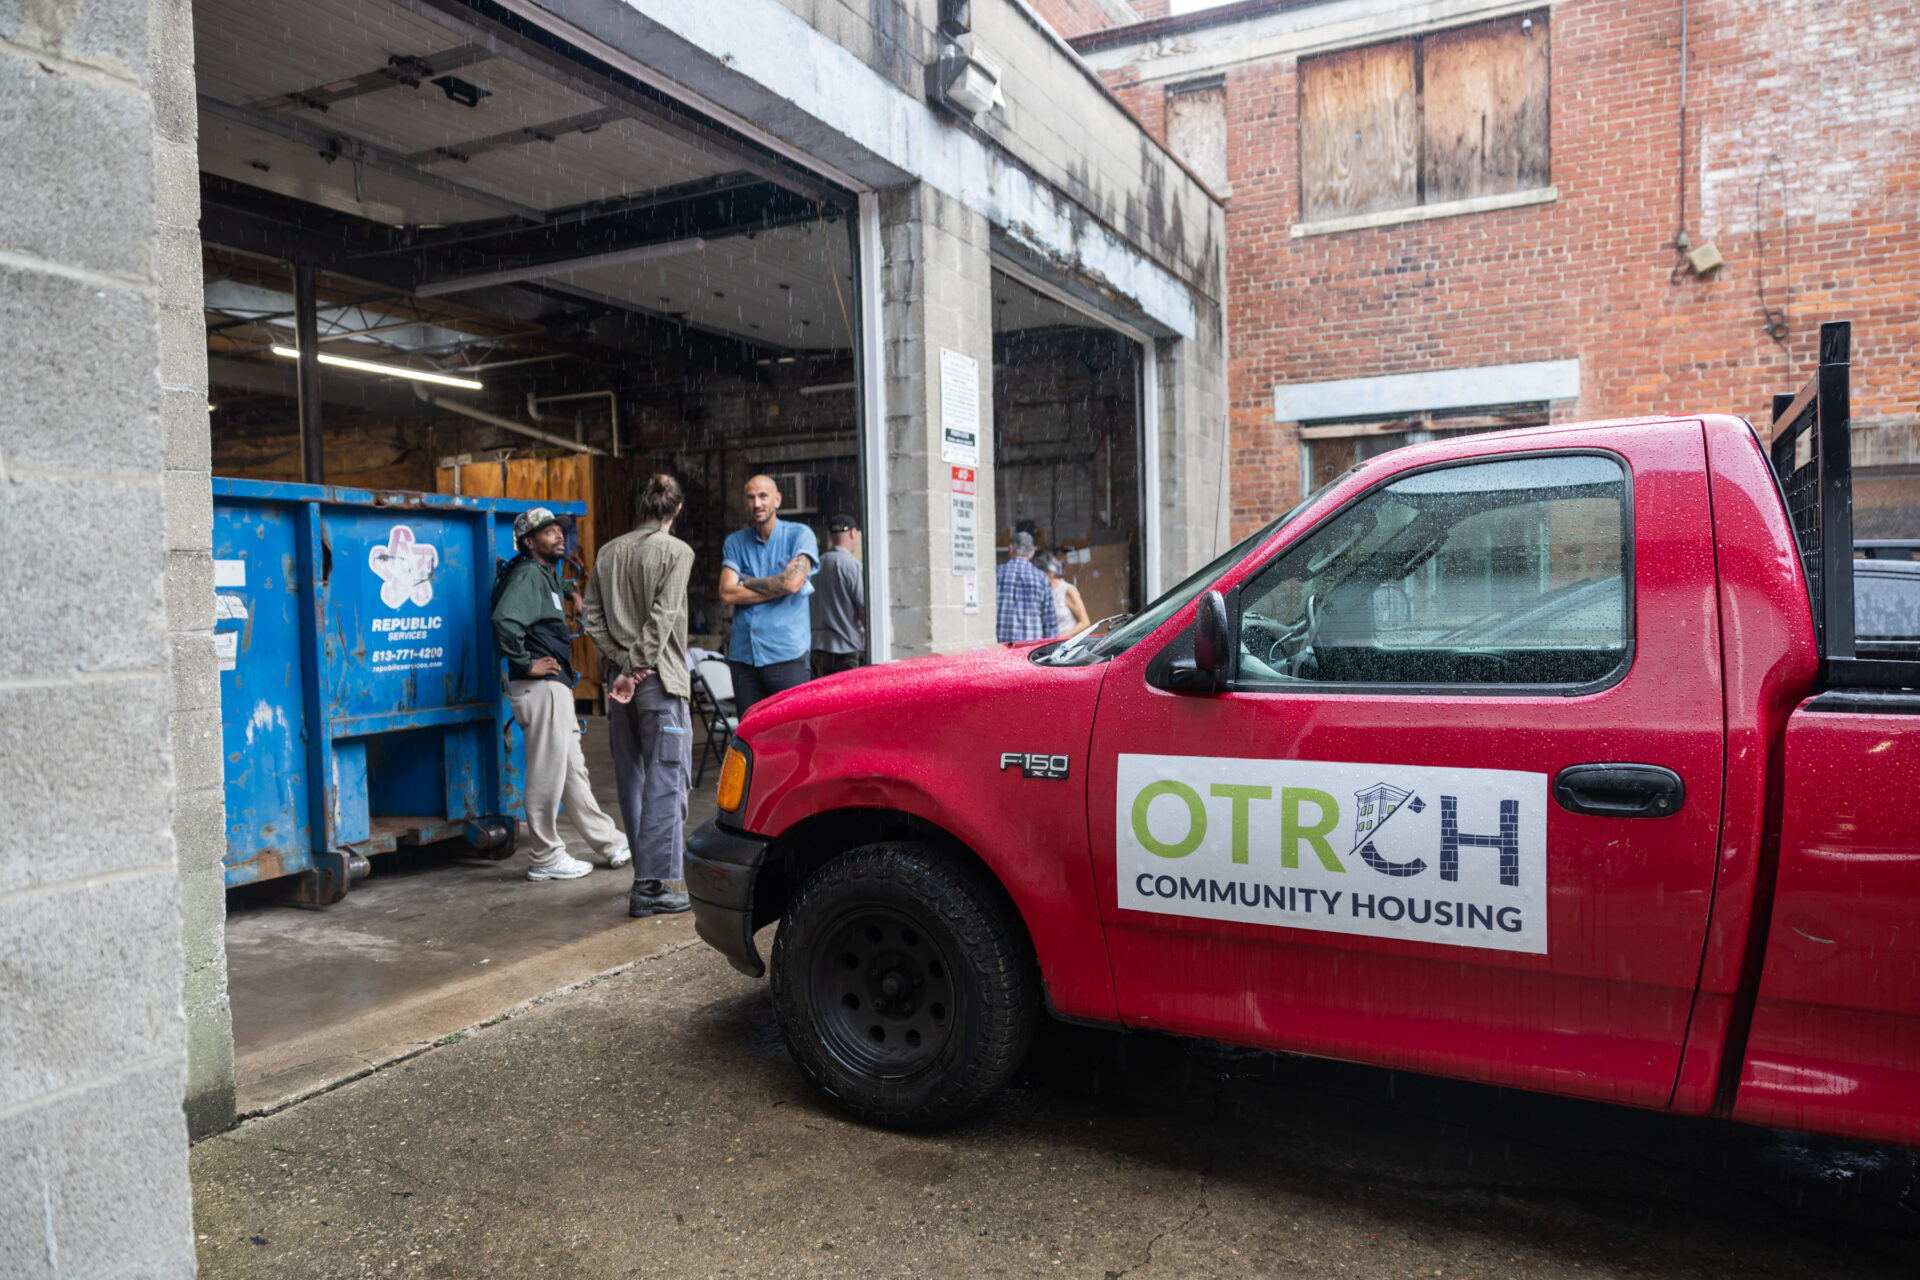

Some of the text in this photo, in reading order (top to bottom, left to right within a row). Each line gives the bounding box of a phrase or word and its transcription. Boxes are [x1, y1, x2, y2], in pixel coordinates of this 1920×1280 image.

[372, 616, 442, 632] REPUBLIC
[388, 631, 427, 641] SERVICES
[372, 647, 443, 662] 513-771-4200
[1000, 752, 1069, 771] F-150
[1135, 873, 1523, 933] COMMUNITY HOUSING
